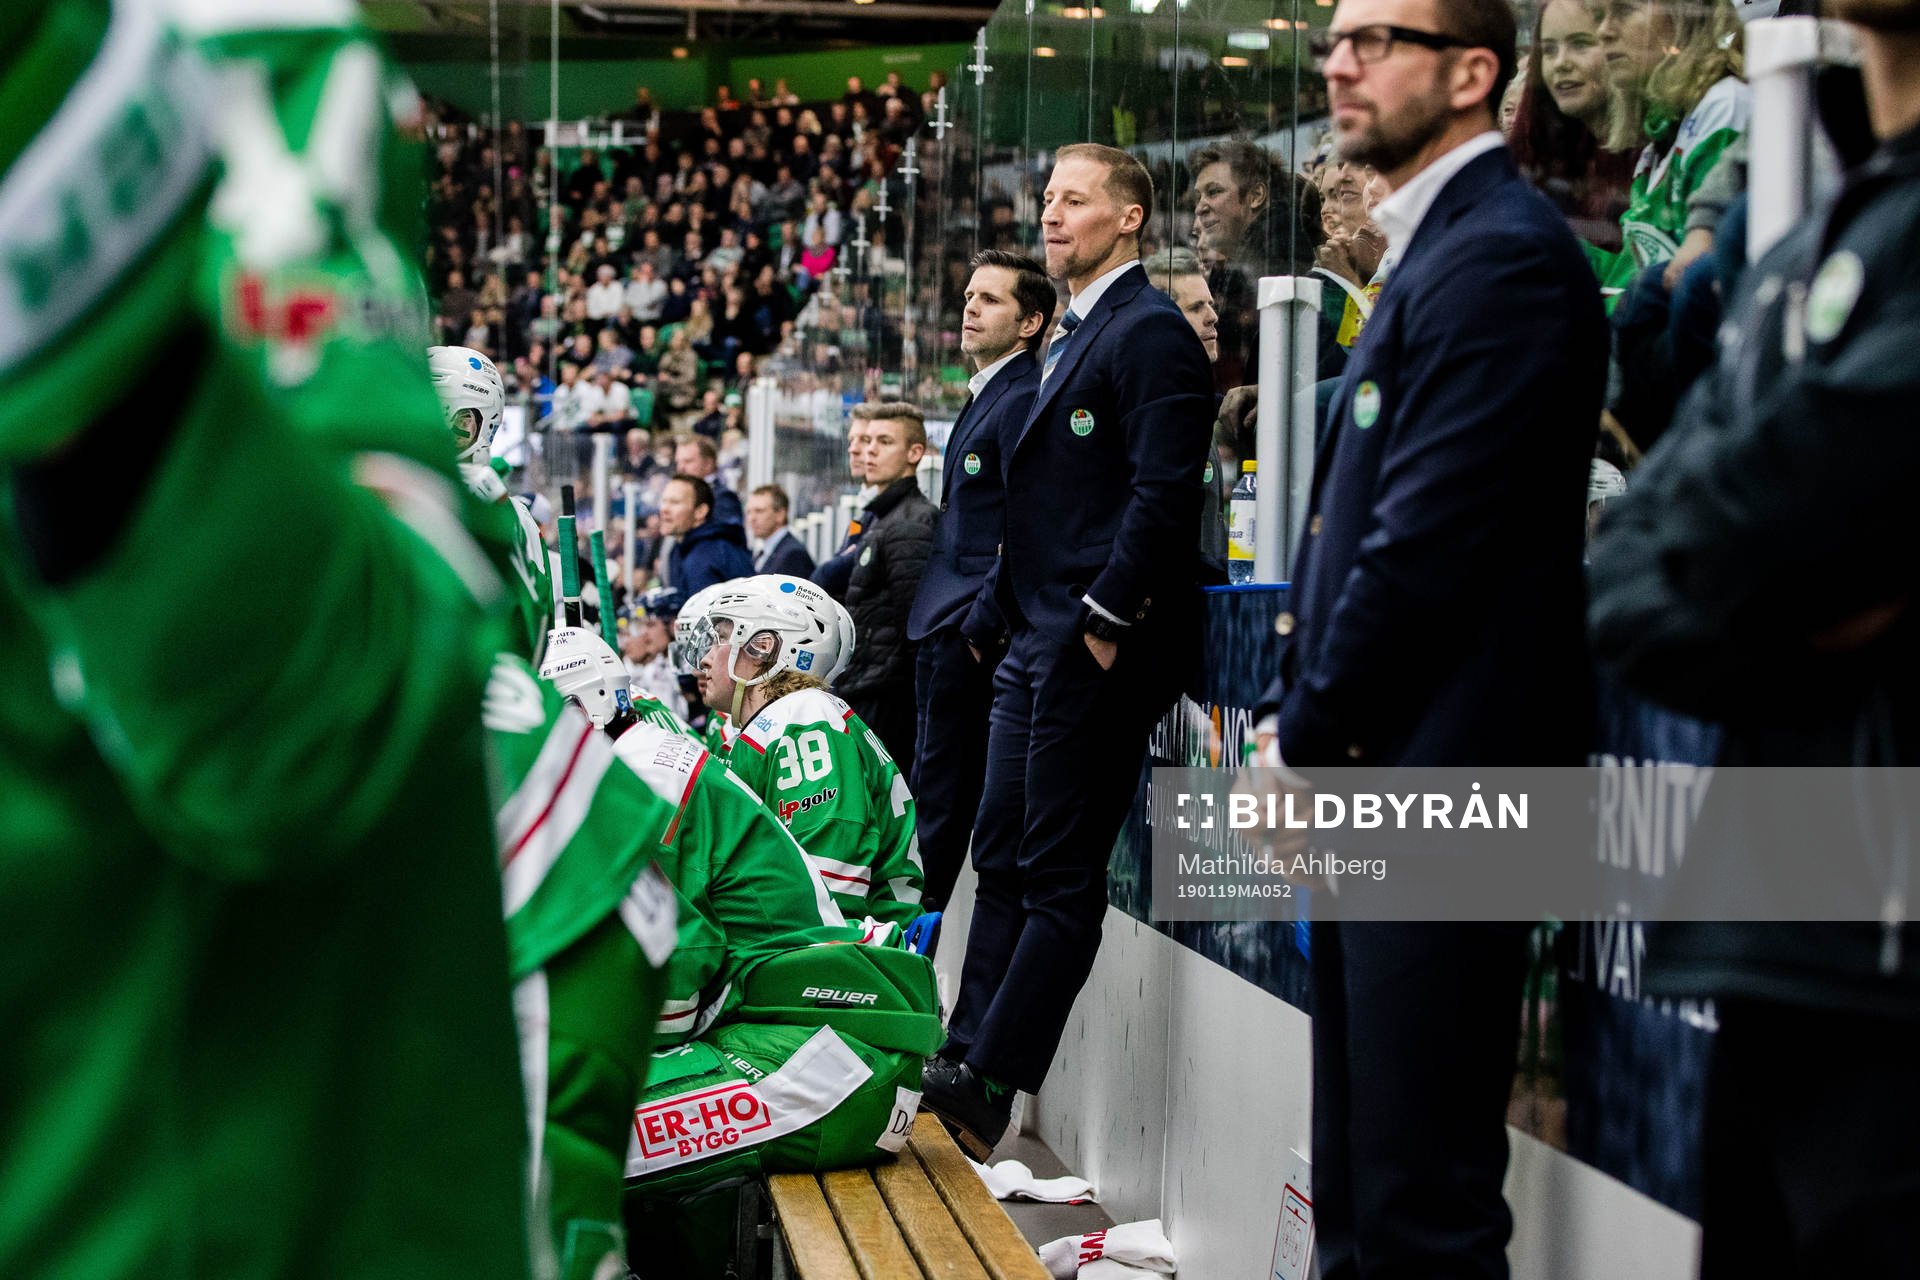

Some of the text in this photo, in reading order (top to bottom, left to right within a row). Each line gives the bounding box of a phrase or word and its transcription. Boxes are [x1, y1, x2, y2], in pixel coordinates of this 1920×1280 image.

[795, 591, 815, 602] Bank
[798, 585, 824, 601] Resurs
[776, 729, 833, 791] 38
[801, 787, 838, 813] golv
[1588, 753, 1714, 878] RNIT
[801, 986, 878, 1006] BAUER
[644, 1091, 759, 1145] ER-HO
[678, 1127, 739, 1158] BYGG
